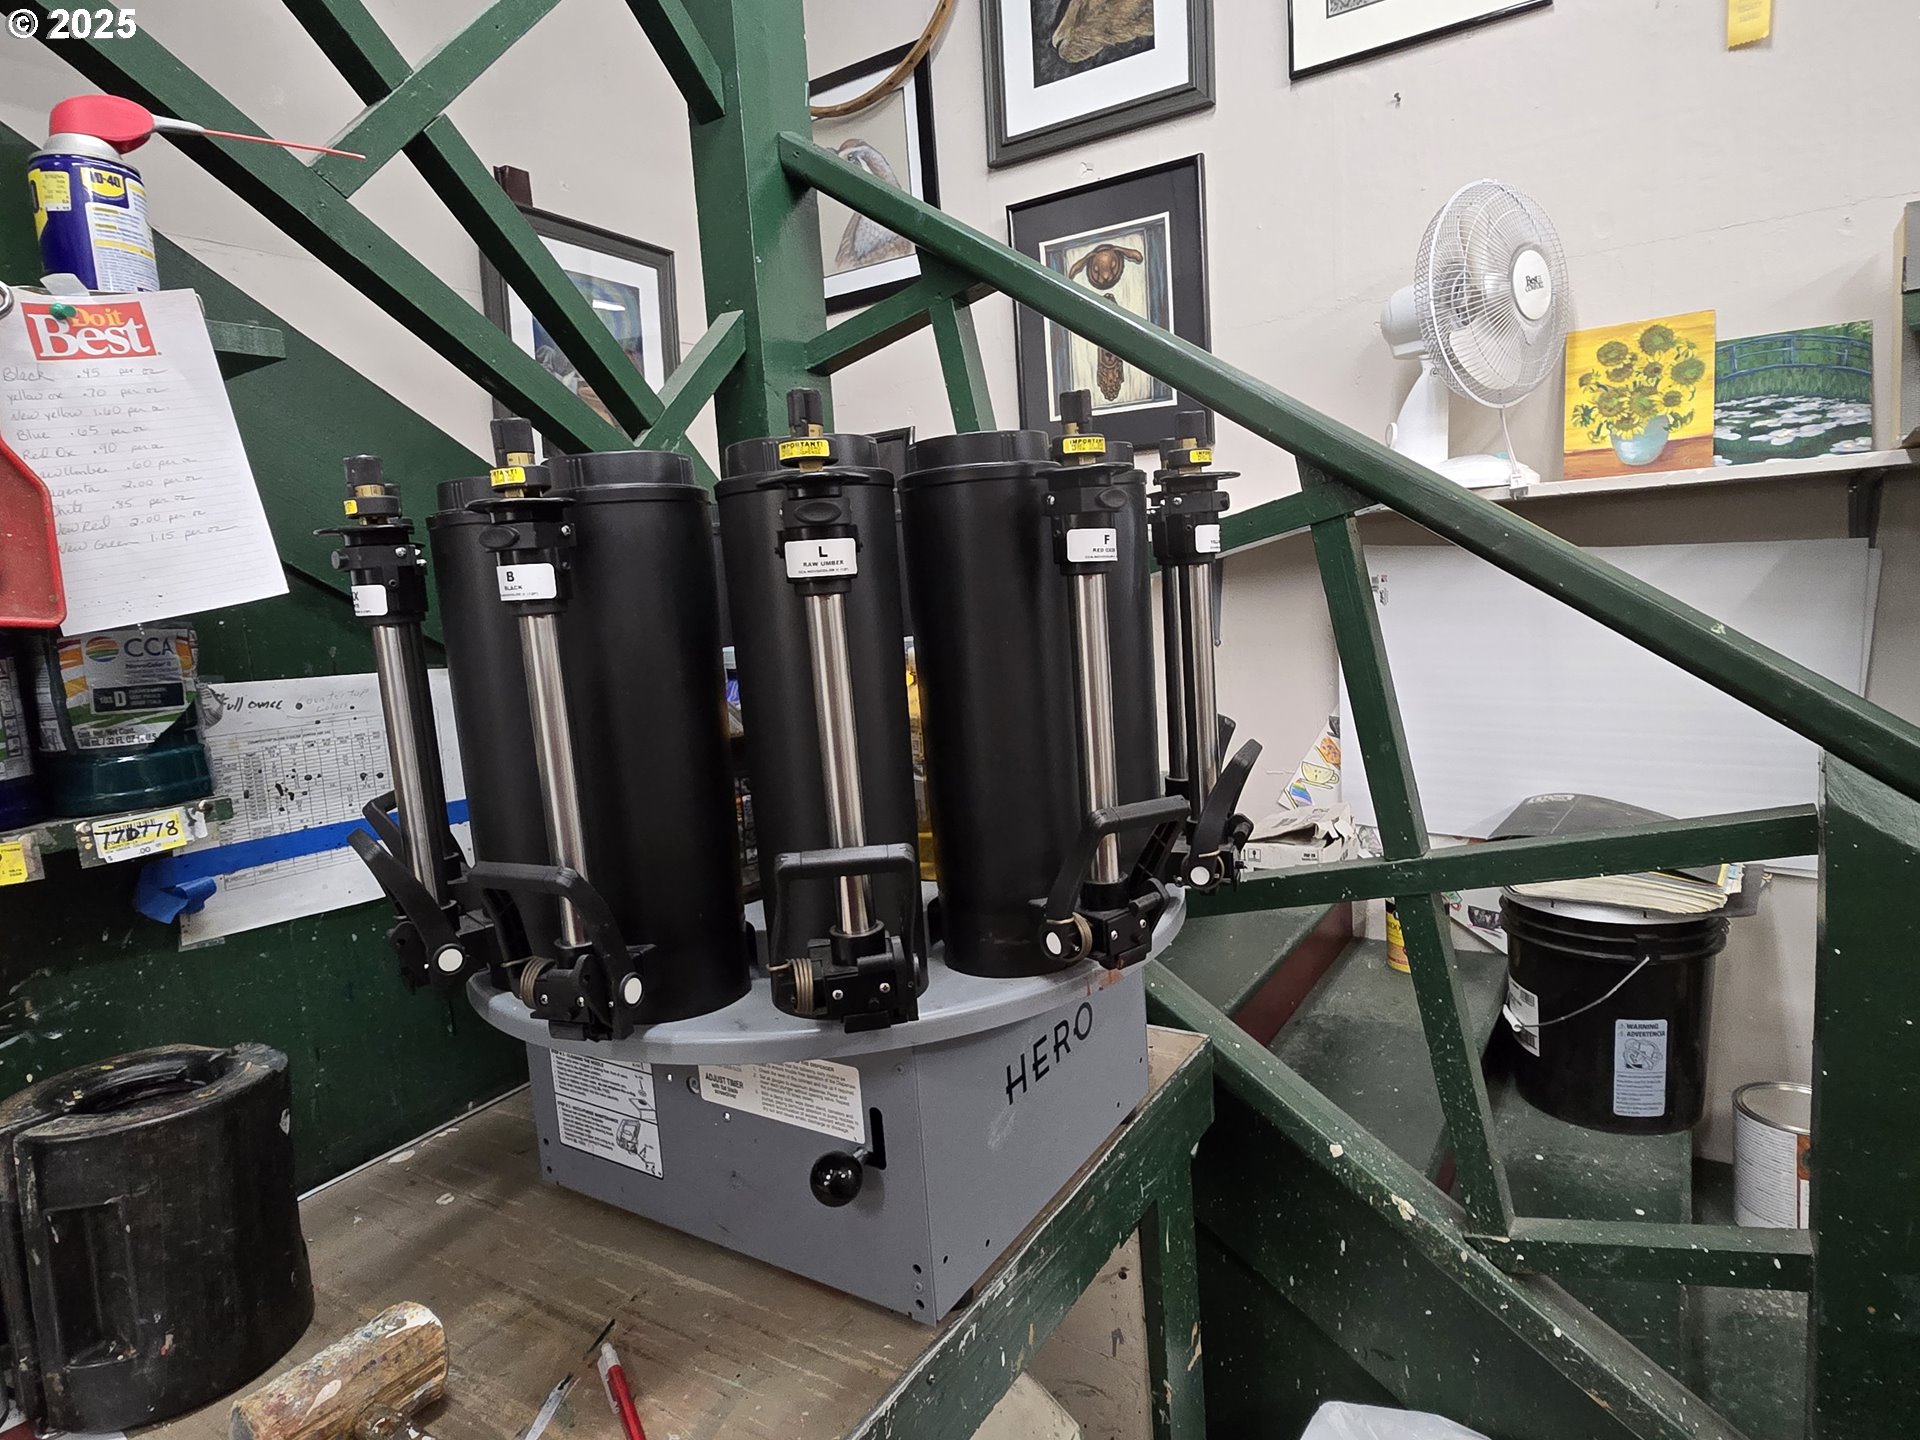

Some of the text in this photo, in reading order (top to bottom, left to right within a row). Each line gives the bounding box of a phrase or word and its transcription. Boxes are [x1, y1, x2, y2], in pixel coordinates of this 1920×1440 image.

[27, 314, 151, 357] Best
[3, 366, 54, 381] Black
[7, 389, 43, 404] yellow
[16, 430, 51, 441] Blue
[22, 447, 50, 461] Red
[50, 484, 101, 501] agenta
[1104, 534, 1111, 545] F
[818, 545, 828, 558] L
[506, 570, 515, 582] B
[124, 638, 174, 657] CCA
[113, 690, 128, 708] D
[1006, 1002, 1092, 1105] HERO
[705, 1072, 744, 1089] ADJUST TIMER
